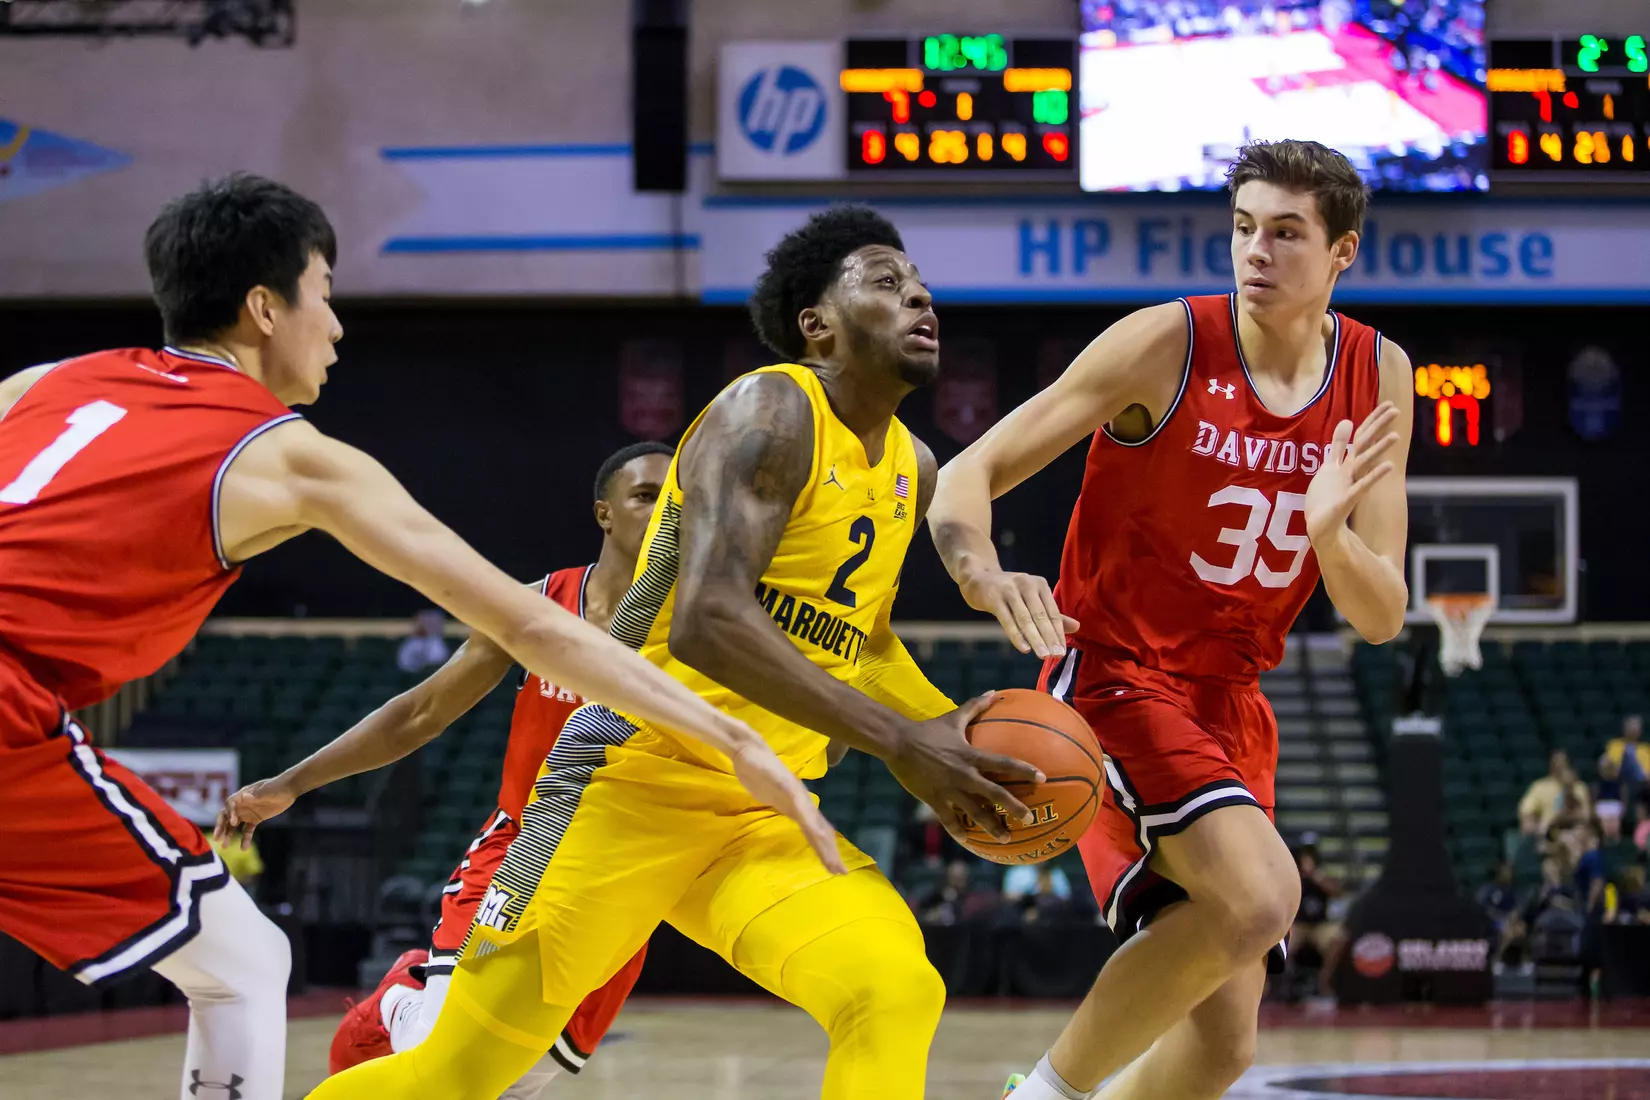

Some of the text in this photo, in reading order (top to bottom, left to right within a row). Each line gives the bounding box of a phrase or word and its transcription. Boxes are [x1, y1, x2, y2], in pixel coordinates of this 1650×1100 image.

[746, 68, 819, 154] hp
[1019, 219, 1109, 275] HP
[1137, 217, 1233, 275] Fie
[0, 400, 128, 504] 1
[1190, 420, 1354, 476] DAVIDS
[824, 515, 876, 608] 2
[1189, 484, 1313, 588] 35
[755, 582, 868, 666] MARQUETT
[972, 831, 1072, 863] SPAL
